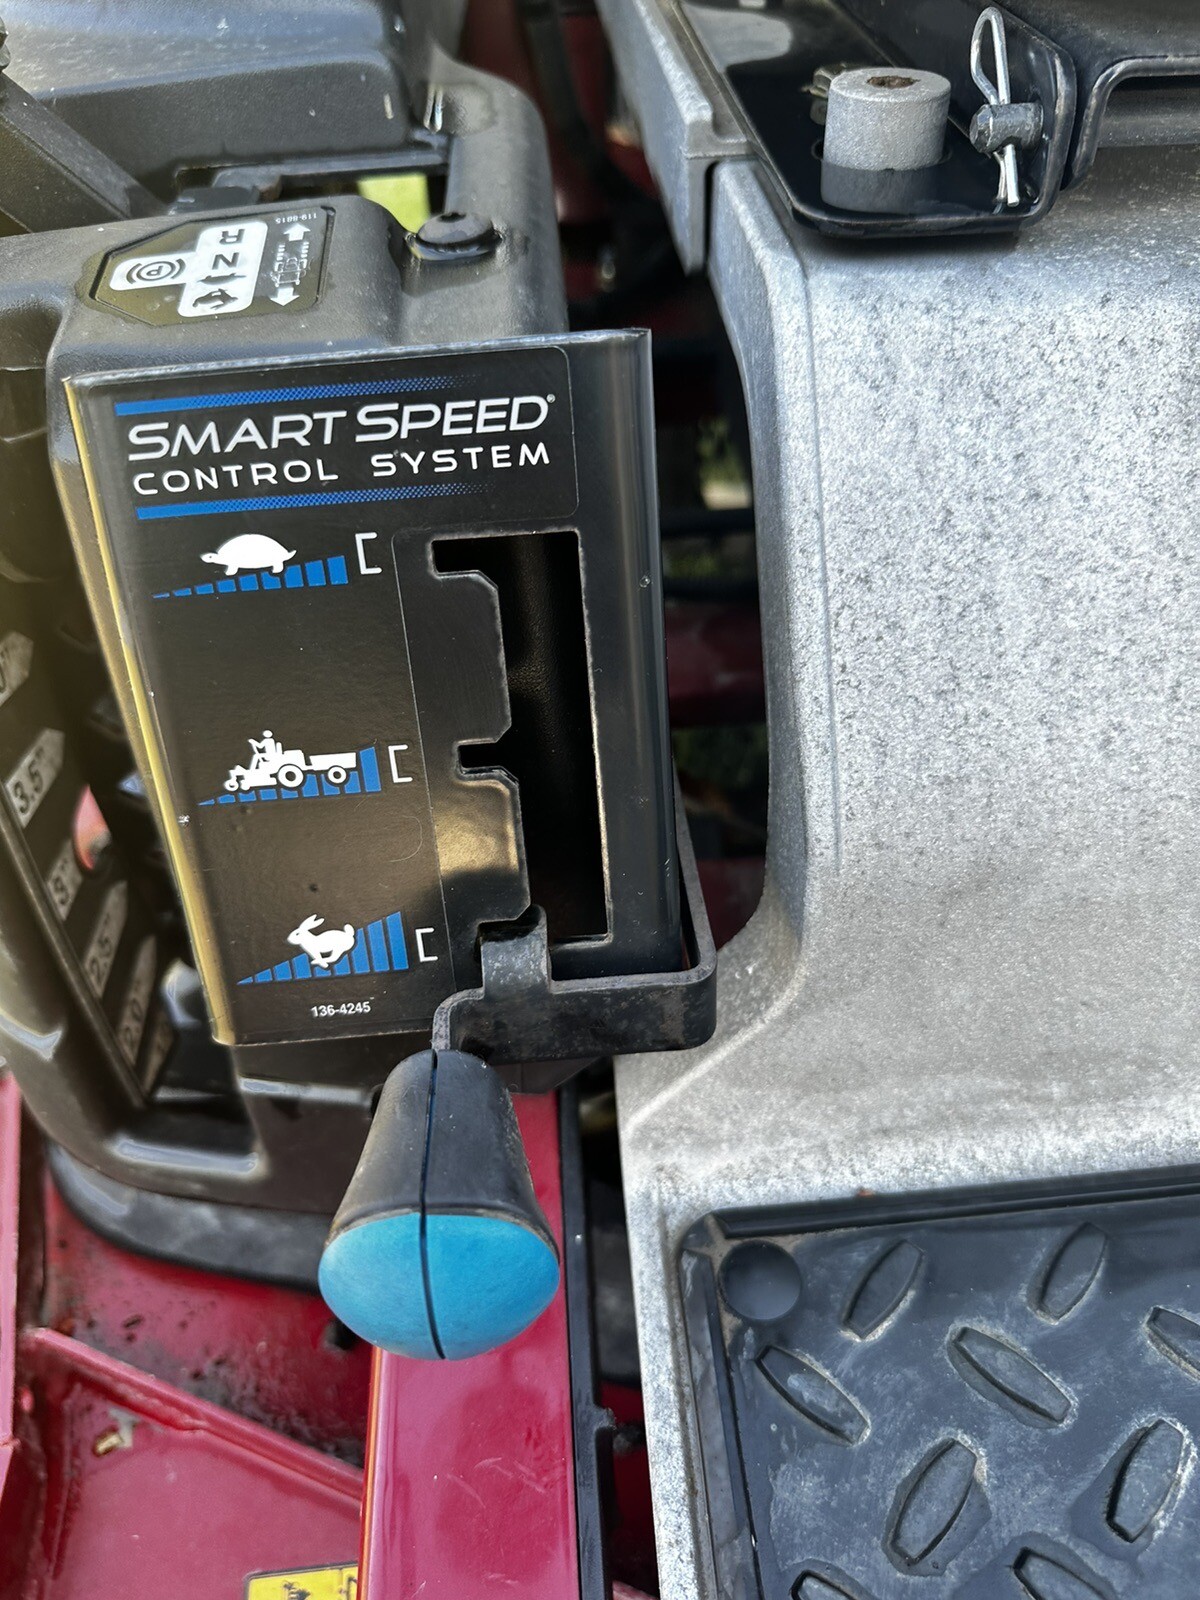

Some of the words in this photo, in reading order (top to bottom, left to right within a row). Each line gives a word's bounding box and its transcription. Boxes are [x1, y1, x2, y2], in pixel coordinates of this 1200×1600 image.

[219, 229, 245, 245] R
[212, 252, 239, 270] N
[145, 265, 164, 276] P
[128, 409, 347, 461] SMART
[133, 458, 339, 496] CONTROL
[371, 441, 550, 477] SYSTEM
[310, 1001, 371, 1018] 136-4245
